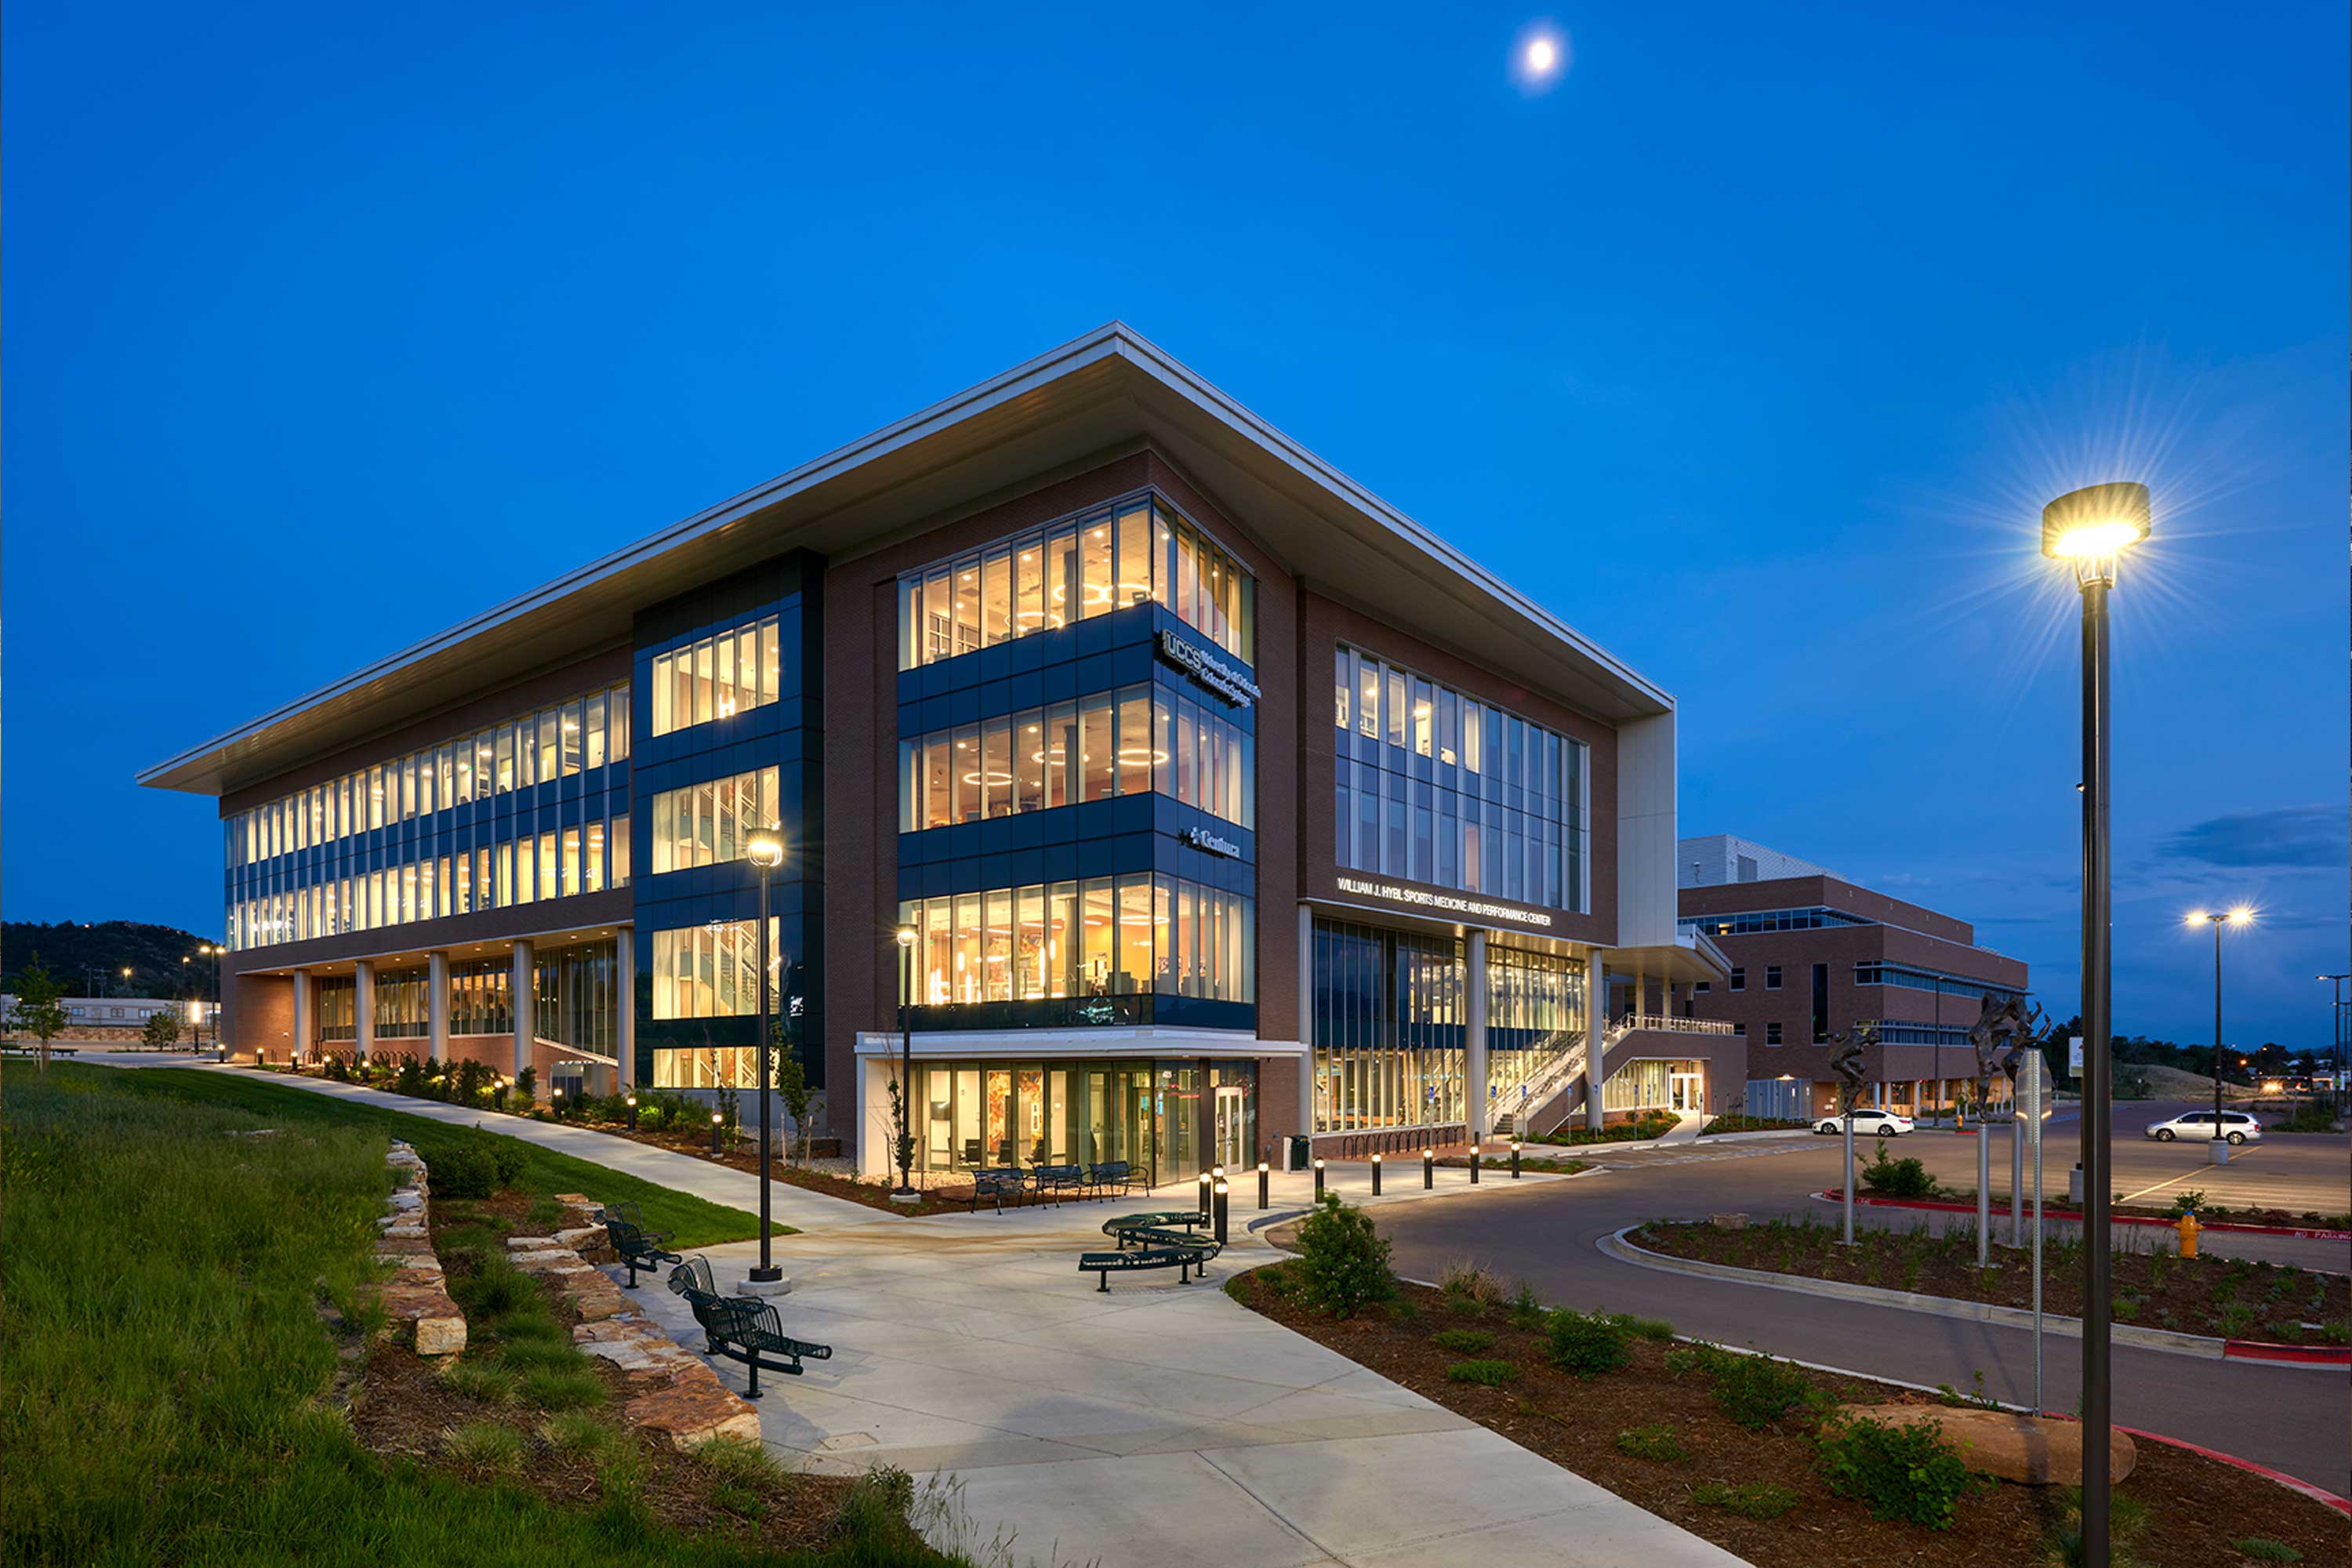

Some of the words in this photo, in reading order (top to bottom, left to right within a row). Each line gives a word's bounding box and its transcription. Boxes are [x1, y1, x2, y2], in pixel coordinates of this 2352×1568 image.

[1165, 633, 1203, 671] UCCS
[1200, 830, 1240, 858] Centura
[1338, 877, 1372, 895] WILLIAM
[1374, 884, 1381, 897] J.
[1381, 886, 1403, 901] HYBL
[1403, 889, 1433, 906] SPORTS
[1433, 895, 1467, 912] MEDICINE
[1468, 902, 1482, 915] AND
[1483, 903, 1528, 923] PERFORMANCE
[1527, 913, 1551, 926] CENTER
